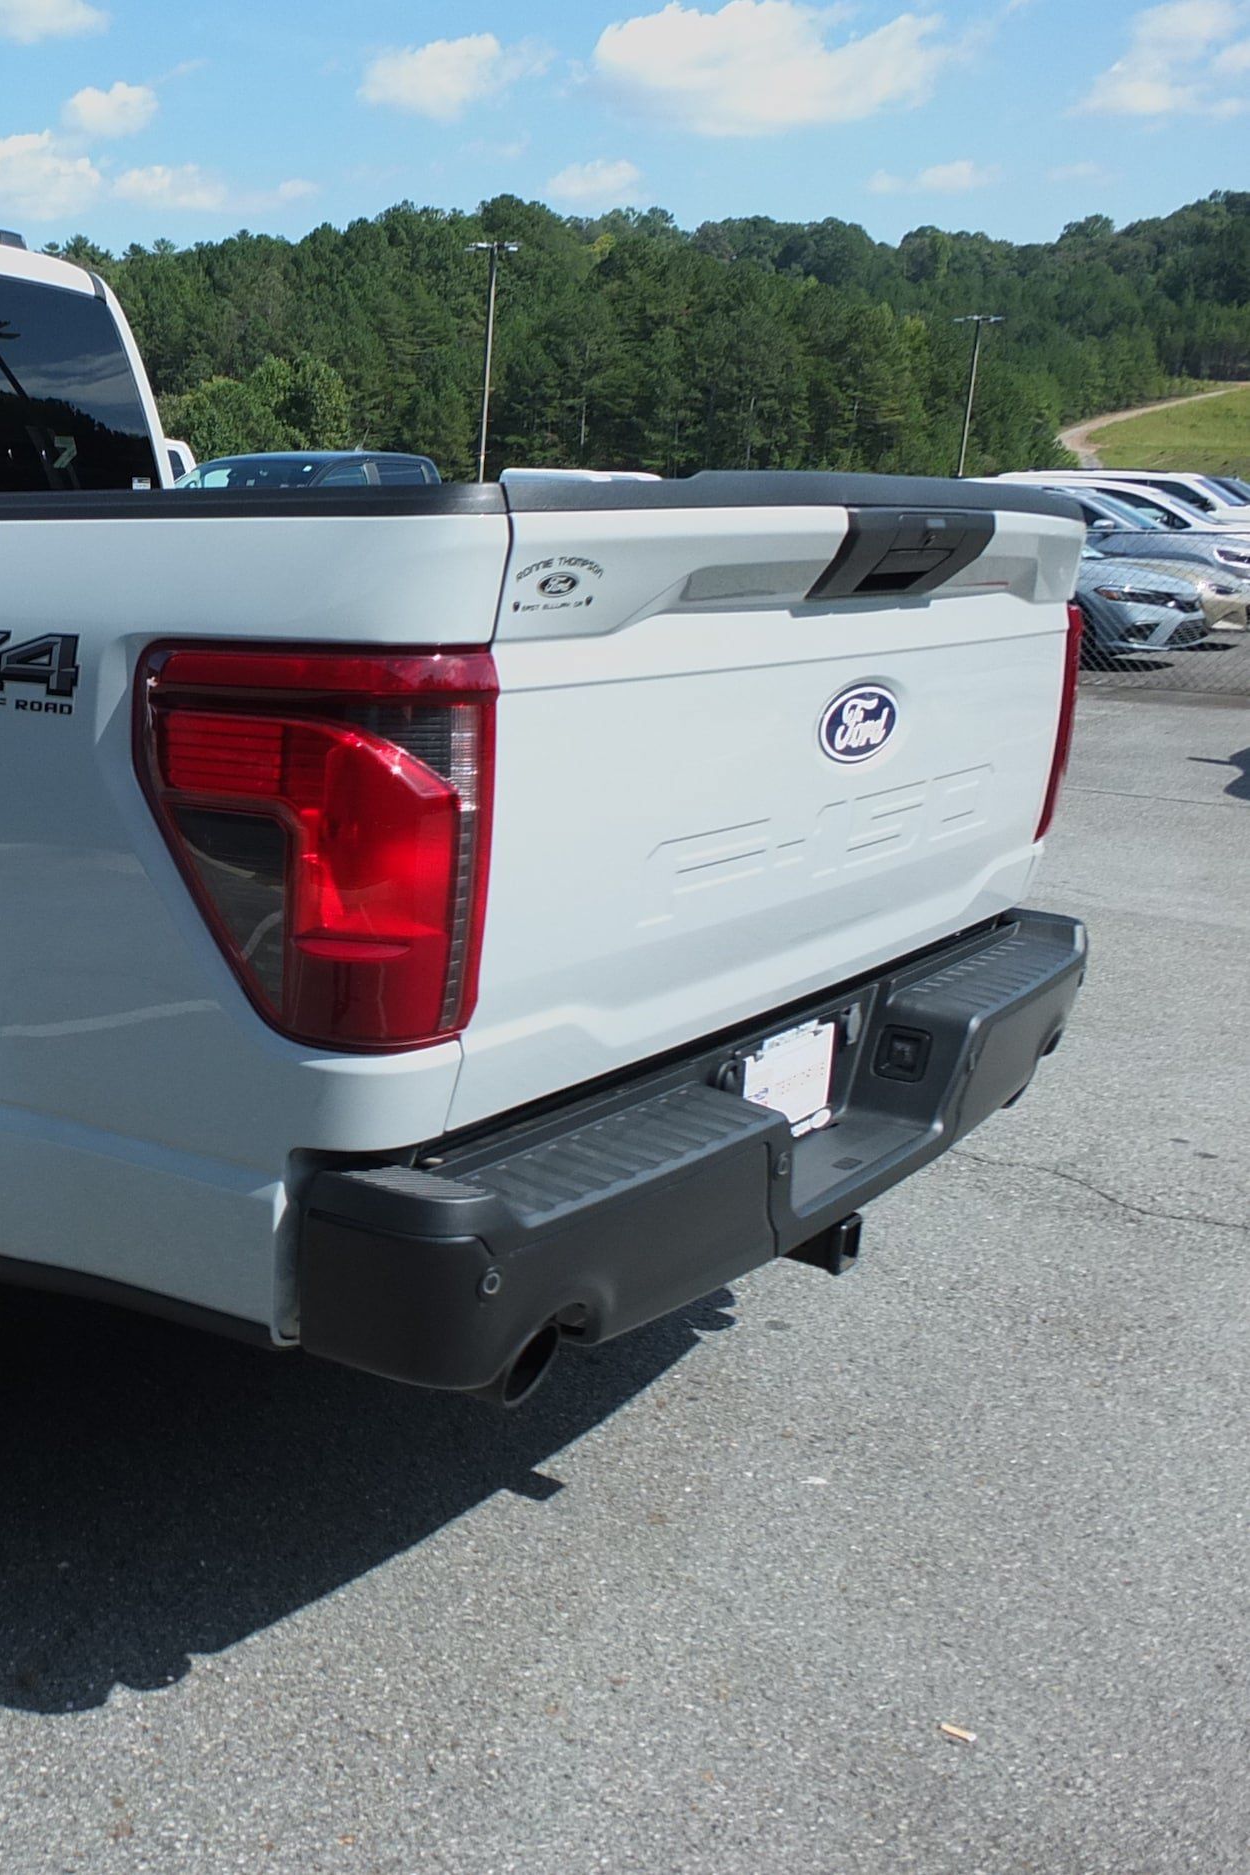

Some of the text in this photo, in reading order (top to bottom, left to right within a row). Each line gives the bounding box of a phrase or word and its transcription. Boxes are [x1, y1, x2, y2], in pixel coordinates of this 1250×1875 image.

[15, 699, 73, 716] ROAD
[834, 697, 890, 751] Ford
[636, 763, 996, 929] F-150
